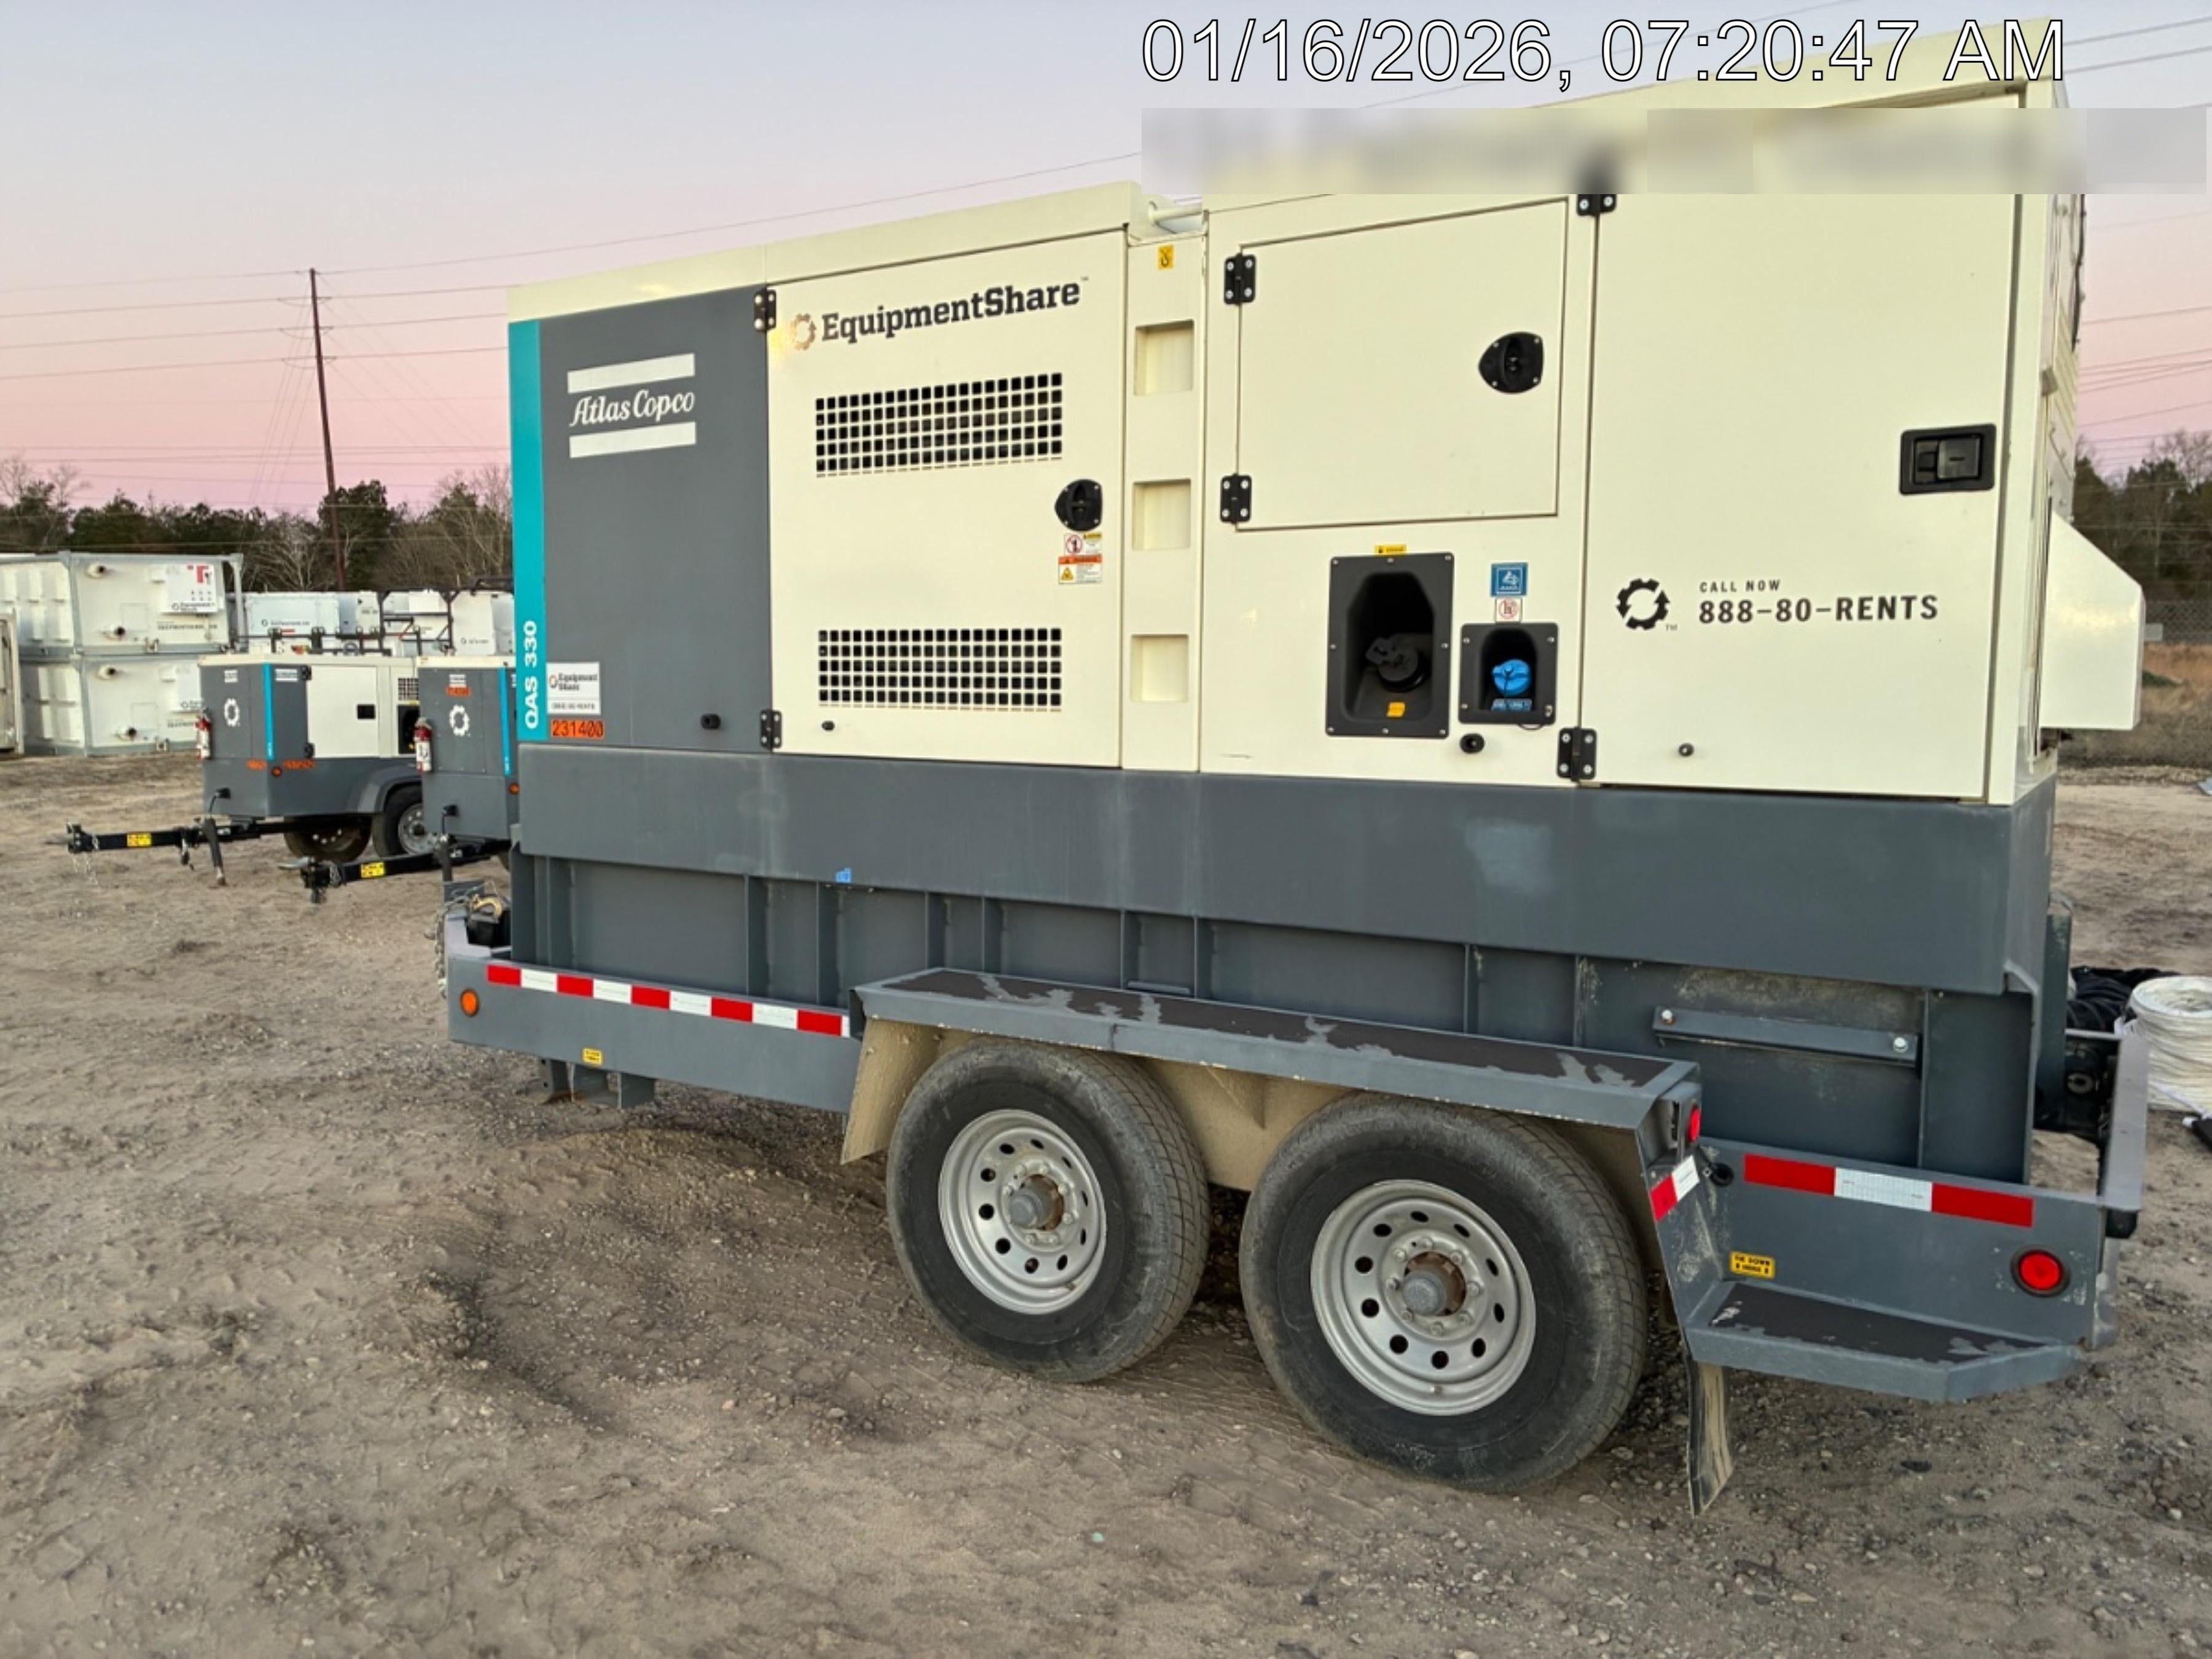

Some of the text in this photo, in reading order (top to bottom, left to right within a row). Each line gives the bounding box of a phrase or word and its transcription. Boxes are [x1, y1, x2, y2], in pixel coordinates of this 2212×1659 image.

[822, 282, 1080, 344] EquipmentShare
[569, 388, 695, 427] Atlas Copco
[1699, 579, 1781, 592] CALL NOW
[1698, 595, 1939, 624] 888-80-RENTS
[524, 620, 537, 668] 330
